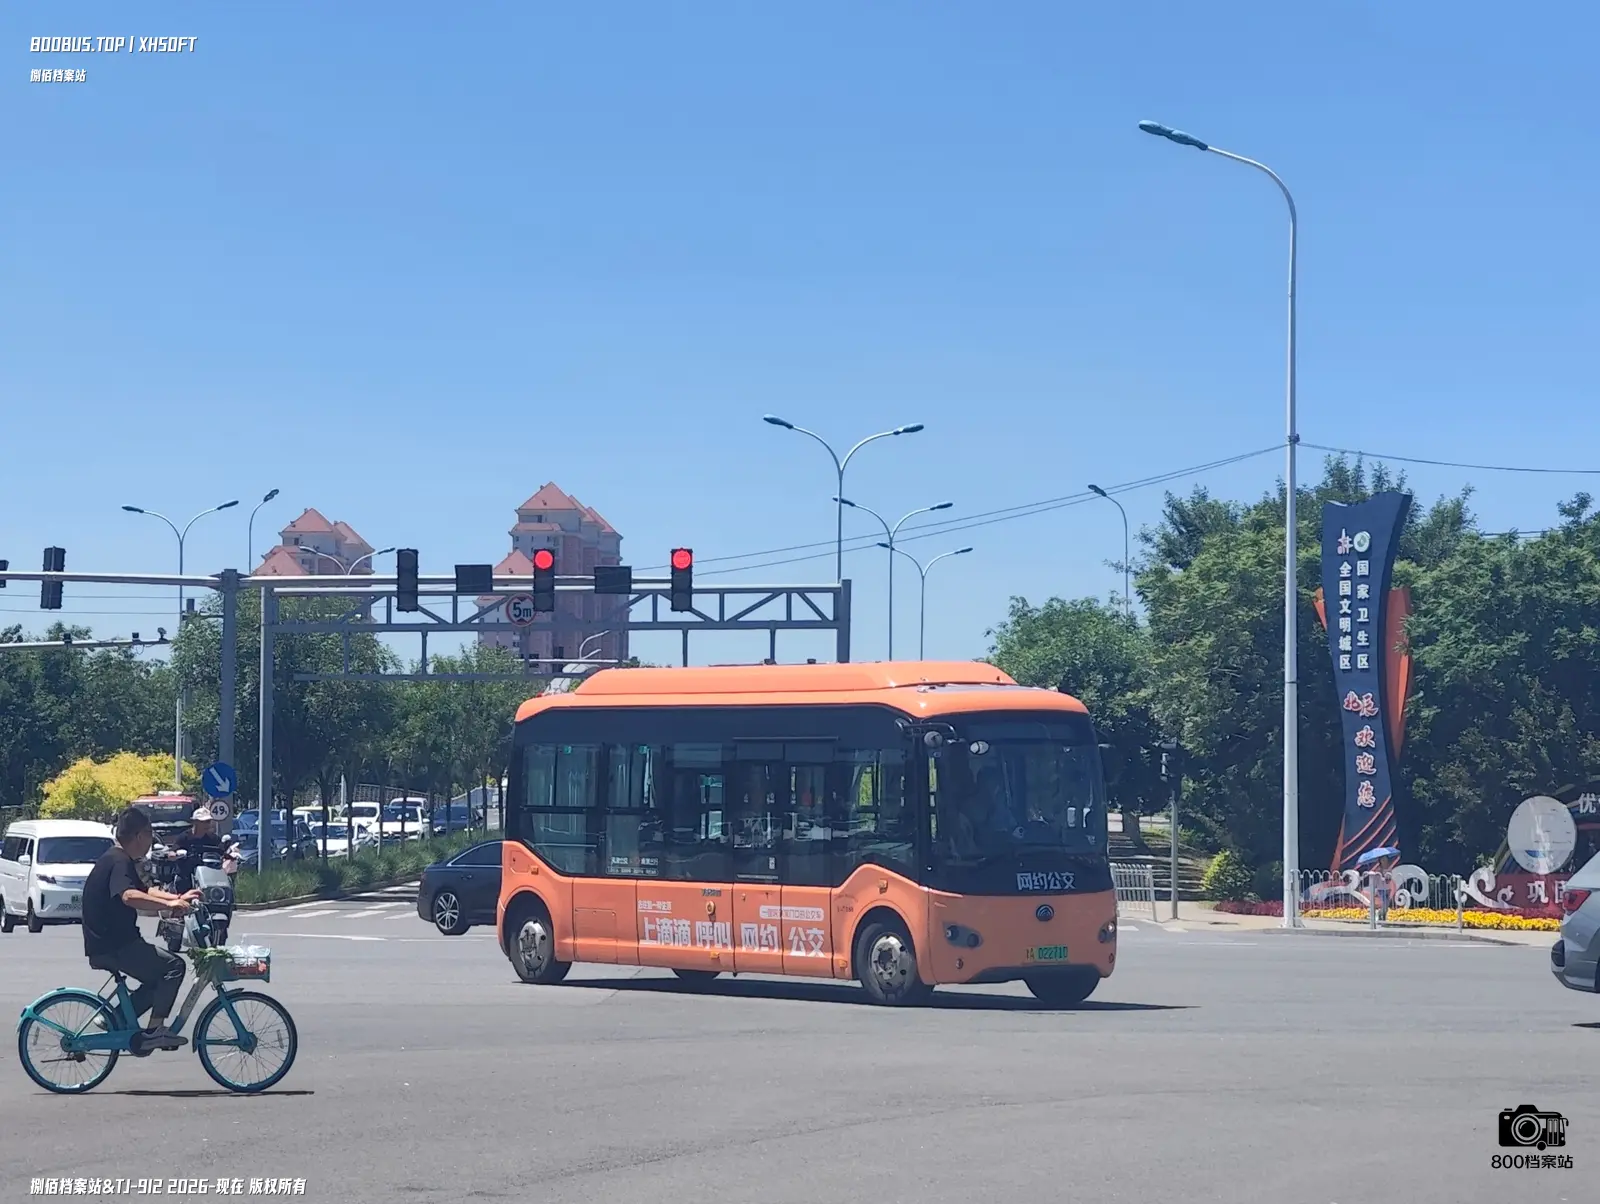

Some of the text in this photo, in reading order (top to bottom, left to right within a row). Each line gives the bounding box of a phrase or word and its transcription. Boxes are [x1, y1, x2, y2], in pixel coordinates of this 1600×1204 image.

[513, 602, 532, 618] 5m
[1338, 561, 1353, 671] 全国文明城区
[1356, 560, 1370, 669] 国家卫生区
[1578, 792, 1600, 814] 优
[1016, 871, 1076, 891] 网约公交
[639, 917, 827, 957] 上滴滴 呼叫 网约 公交
